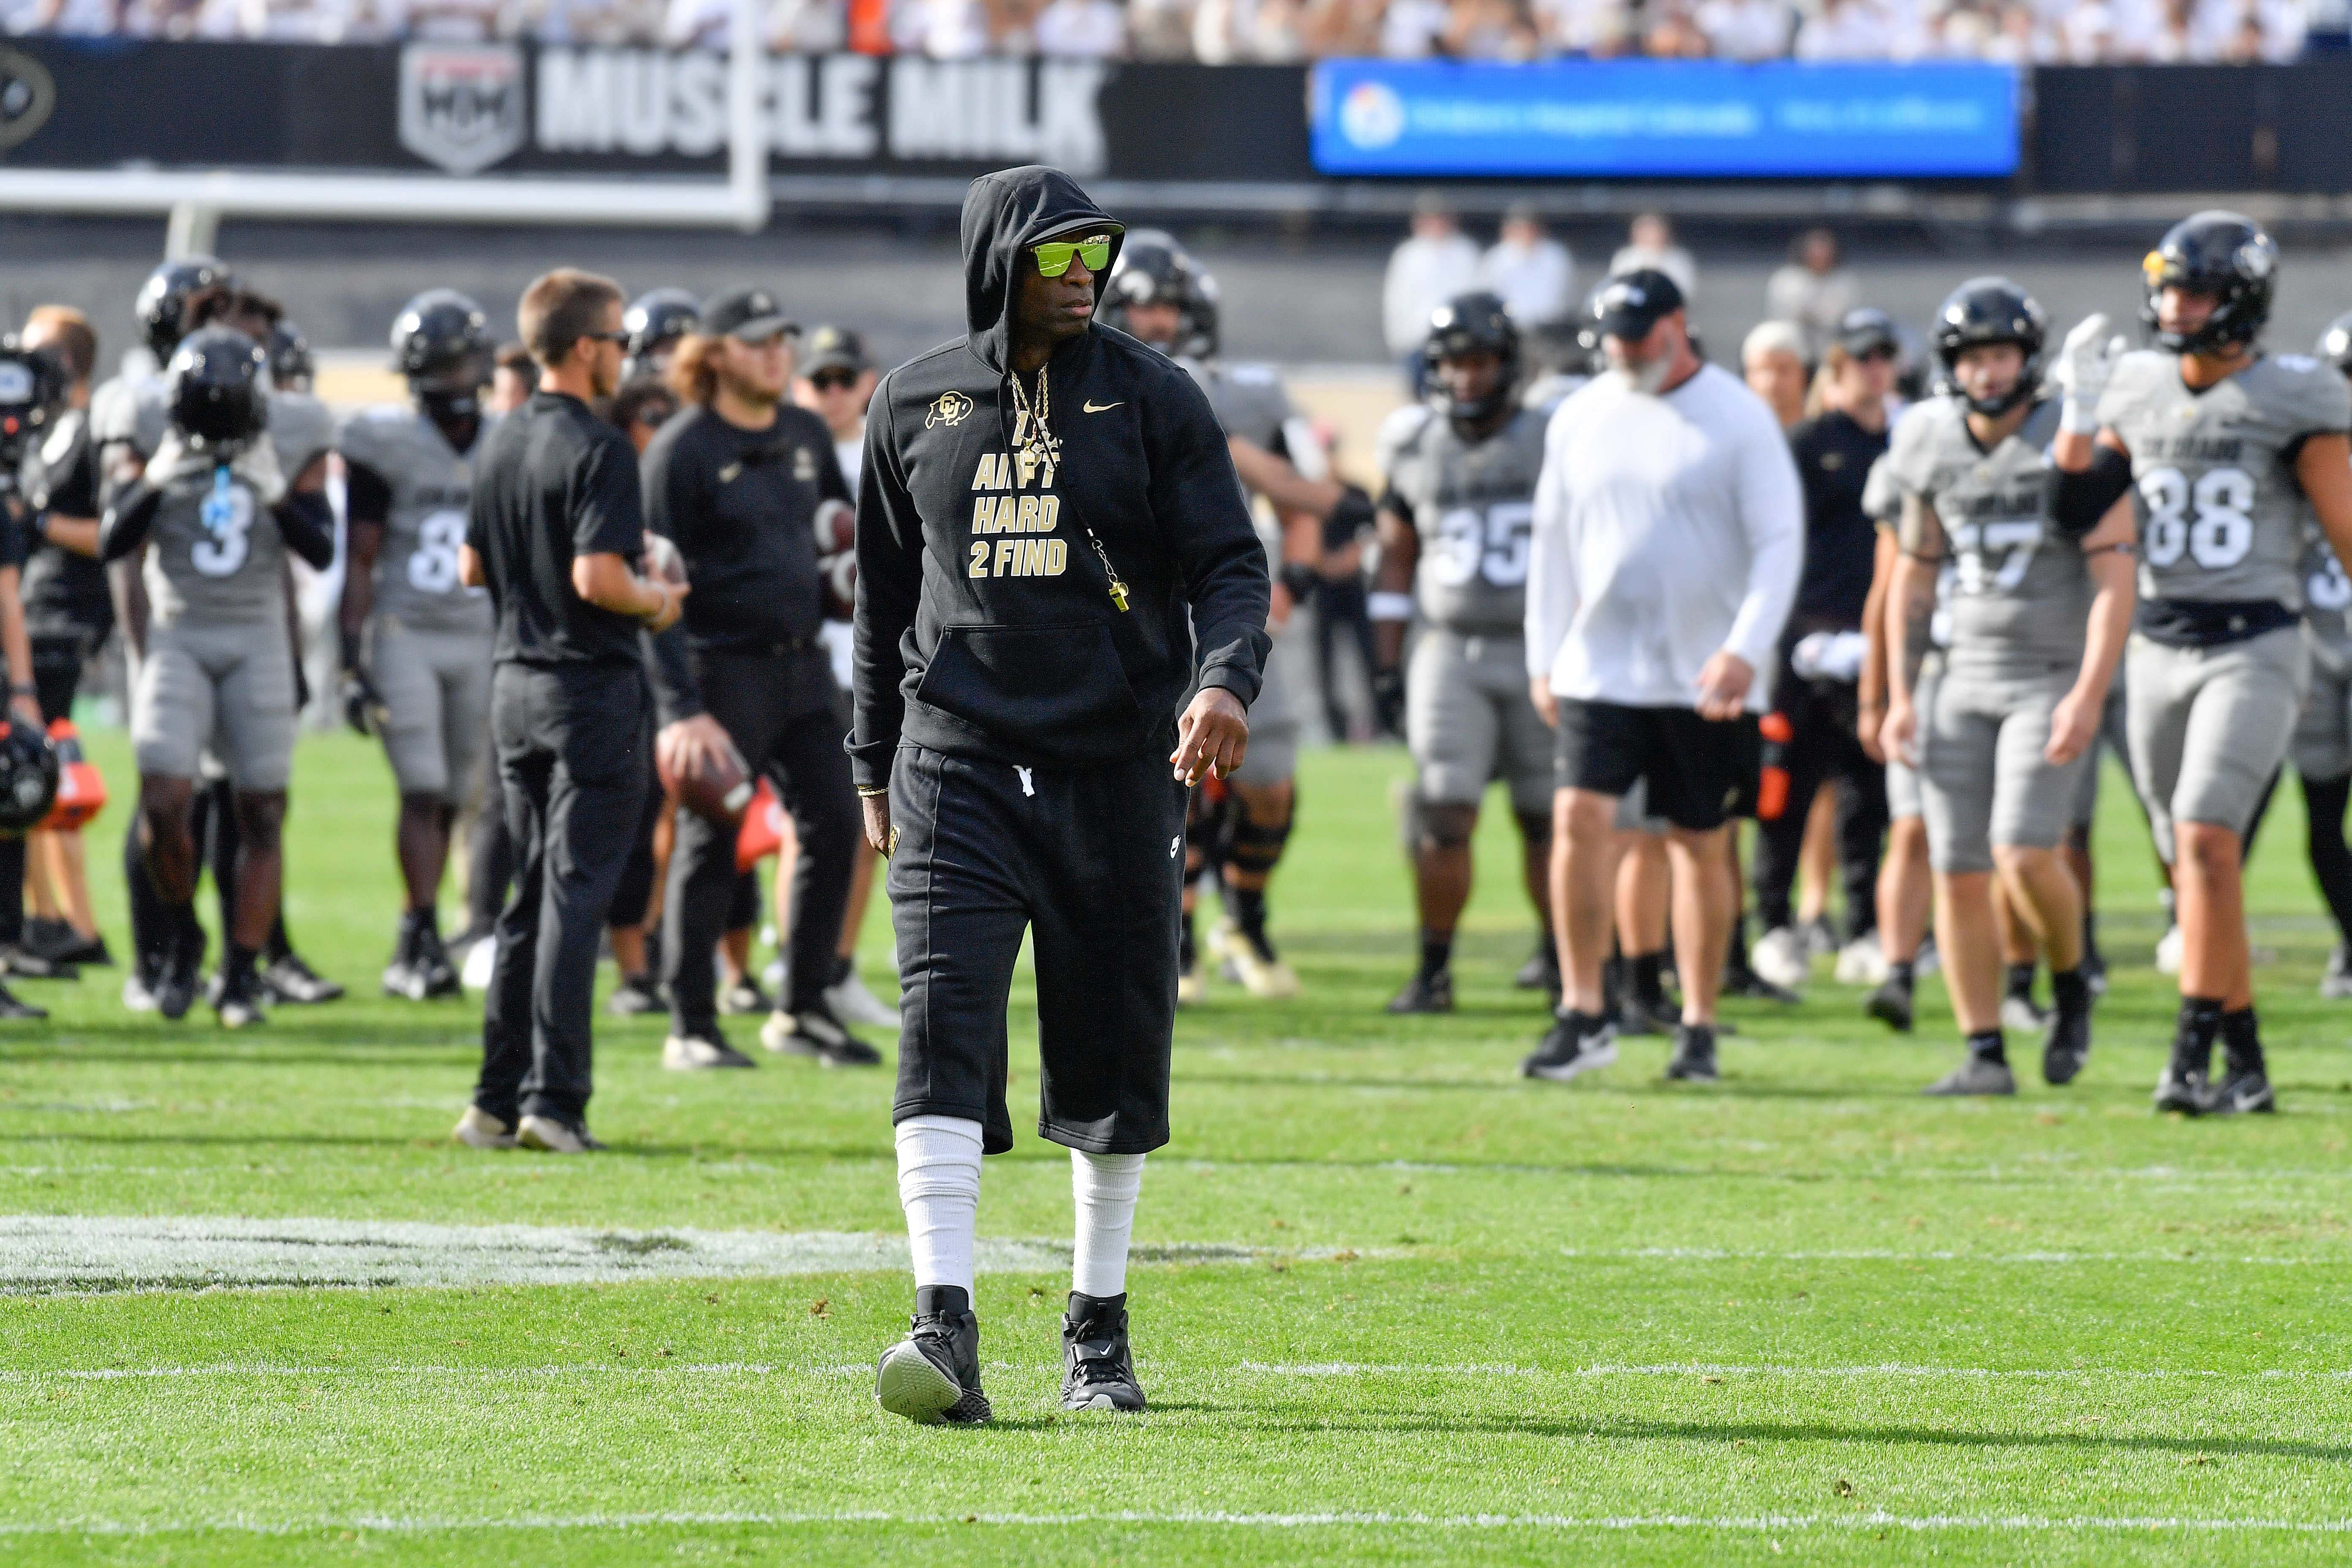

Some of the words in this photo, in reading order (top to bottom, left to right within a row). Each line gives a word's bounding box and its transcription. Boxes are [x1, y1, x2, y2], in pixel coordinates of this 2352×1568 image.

[890, 56, 1108, 174] MILK
[939, 396, 961, 419] CU
[972, 495, 1060, 534] HARD
[2139, 467, 2255, 569] 88
[969, 541, 990, 578] 2
[994, 539, 1067, 577] FIND
